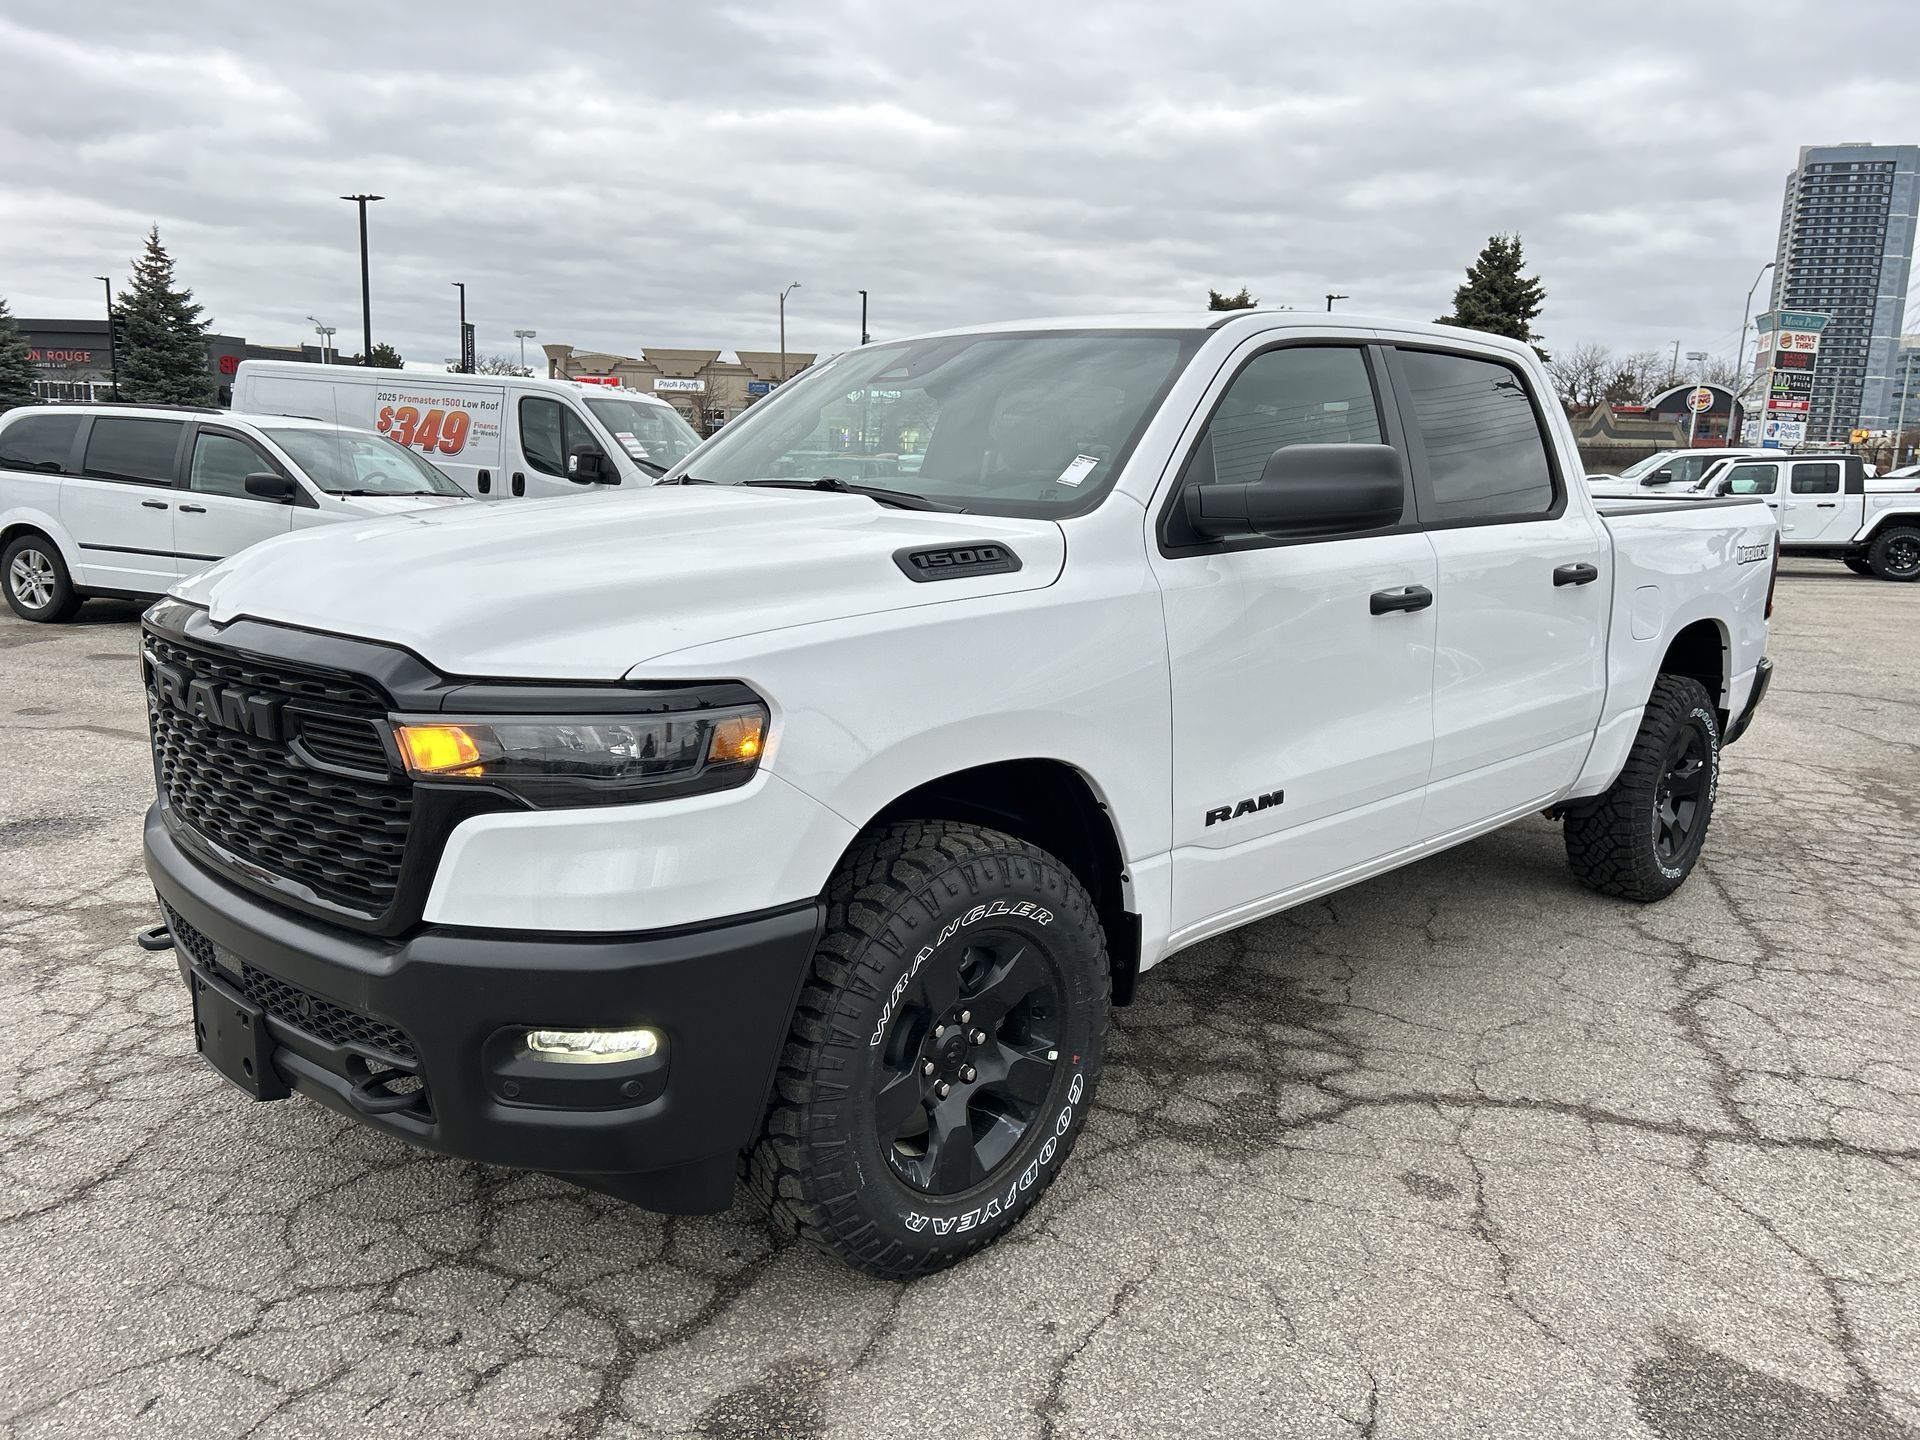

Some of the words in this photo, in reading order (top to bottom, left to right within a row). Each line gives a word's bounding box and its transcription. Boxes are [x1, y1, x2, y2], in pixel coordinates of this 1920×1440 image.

[1795, 334, 1817, 343] DRIVE
[1796, 342, 1815, 350] THRU
[47, 350, 91, 362] ROUGE
[377, 392, 397, 402] 2025
[399, 394, 440, 406] Promaster
[442, 398, 461, 407] 1500
[462, 400, 479, 409] Low
[480, 401, 499, 411] Roof
[377, 405, 472, 457] $349
[473, 421, 499, 430] Finance
[473, 429, 499, 438] Bi-Weekly
[911, 547, 1000, 569] 1500
[157, 662, 282, 742] RAM
[1690, 707, 1719, 802] GOODYEAR
[1205, 789, 1284, 827] RAM
[870, 900, 1054, 1046] WRANGLER
[905, 1073, 1084, 1235] GOODYEAR
